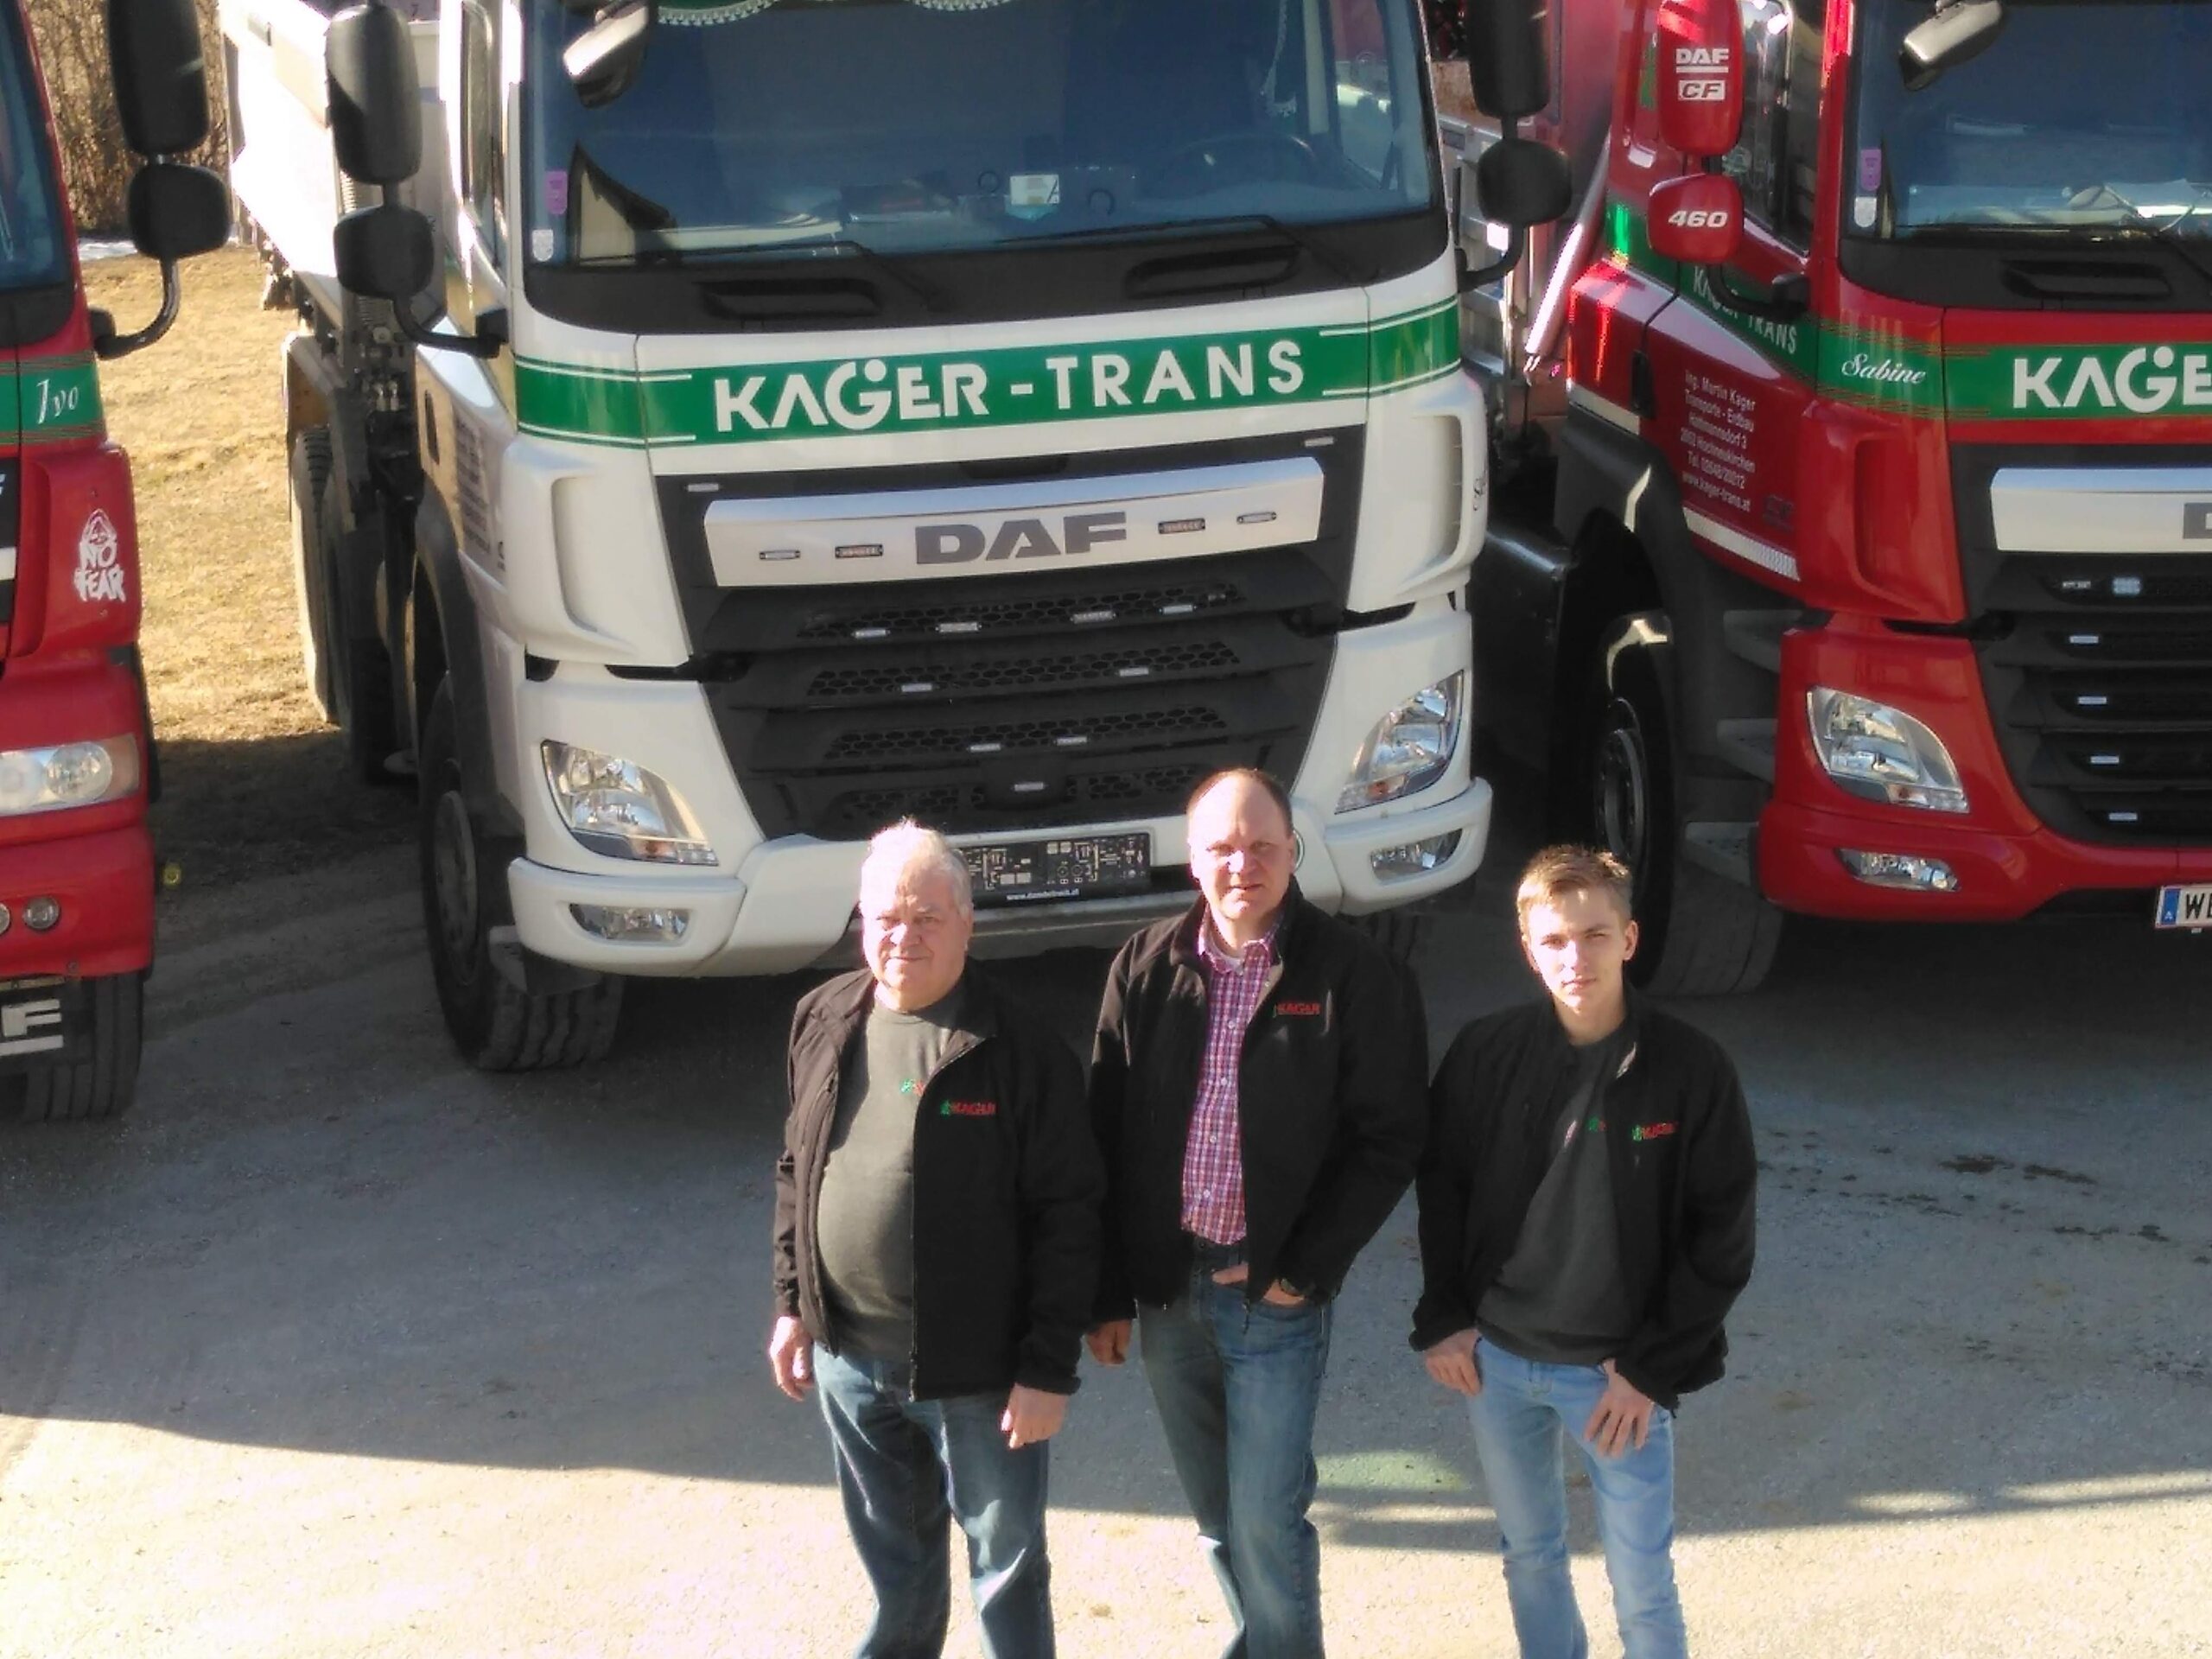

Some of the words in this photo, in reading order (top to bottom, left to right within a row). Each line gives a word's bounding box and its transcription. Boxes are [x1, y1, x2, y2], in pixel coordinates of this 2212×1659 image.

[1675, 48, 1729, 64] DAF
[1681, 83, 1721, 99] CF
[1668, 210, 1729, 228] 460
[1841, 353, 1926, 385] Sabine
[714, 358, 990, 430] KAGER
[1045, 340, 1306, 410] TRANS
[915, 512, 1127, 564] DAF
[79, 539, 117, 569] NO
[73, 563, 126, 601] FEAR
